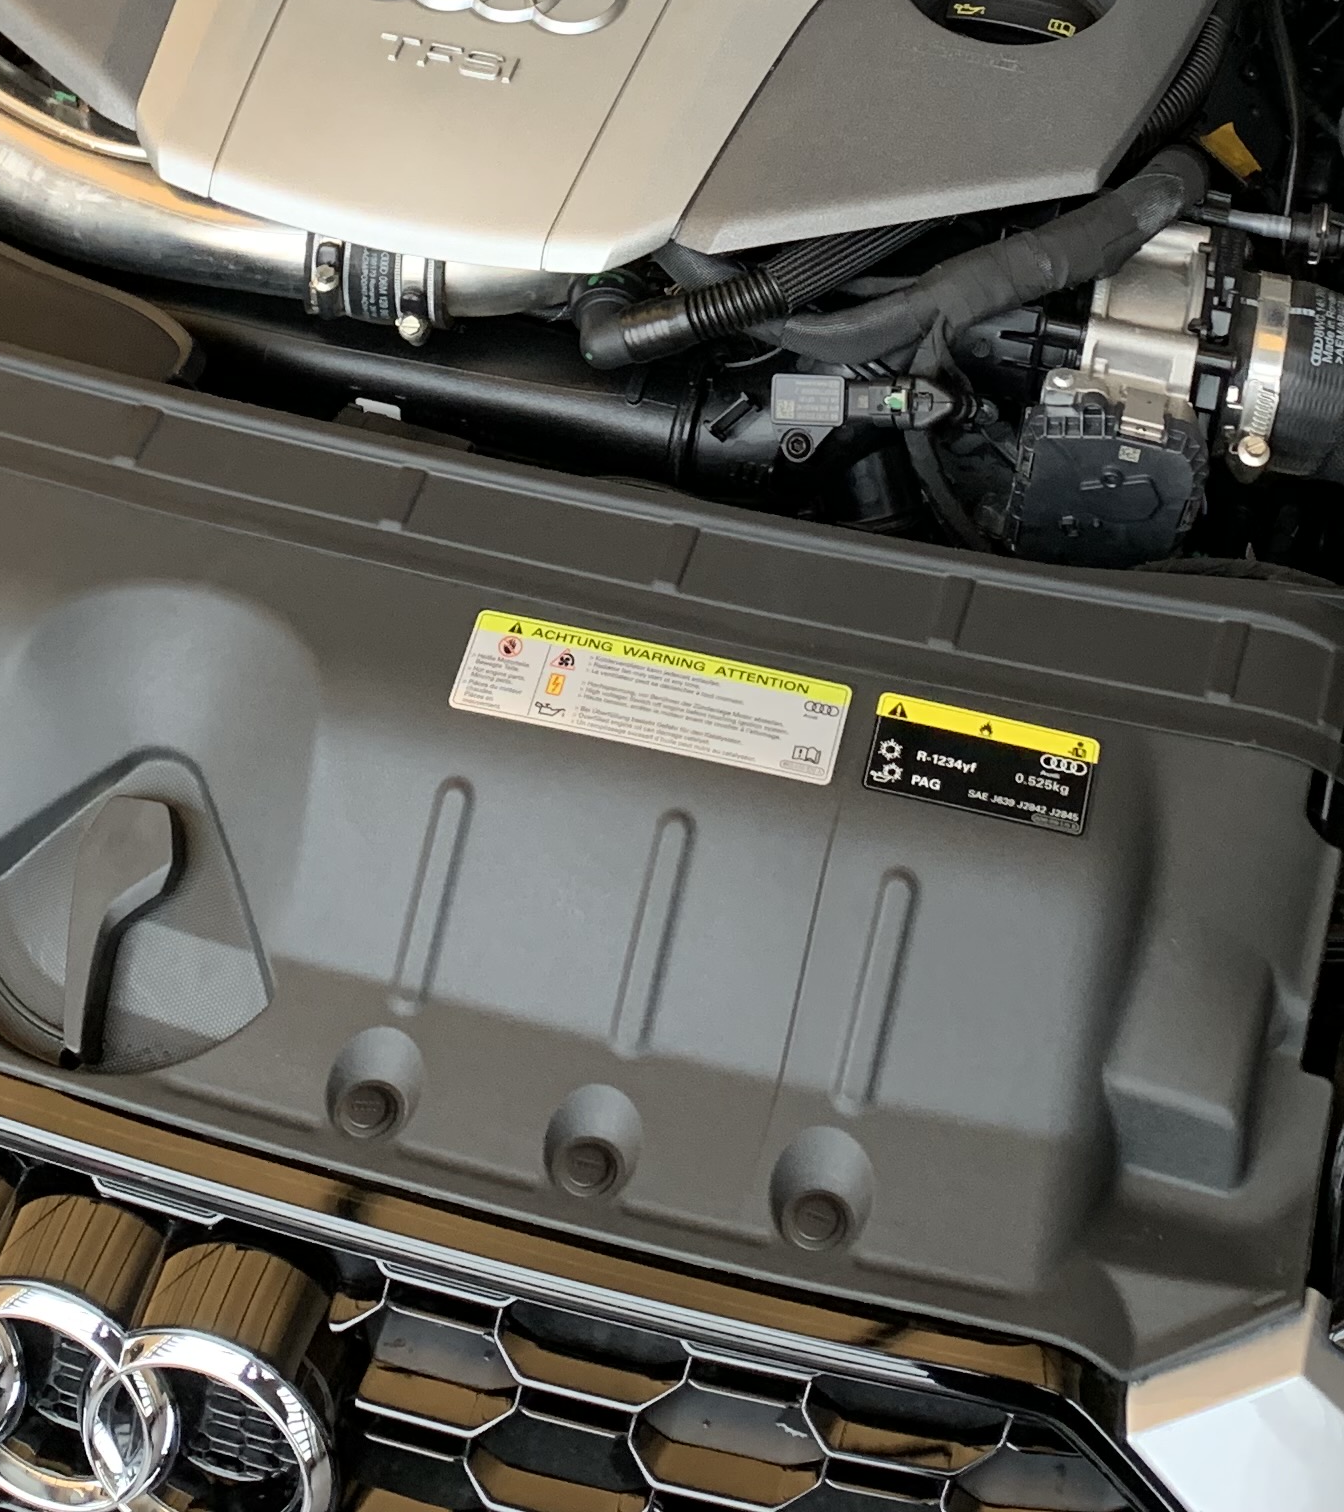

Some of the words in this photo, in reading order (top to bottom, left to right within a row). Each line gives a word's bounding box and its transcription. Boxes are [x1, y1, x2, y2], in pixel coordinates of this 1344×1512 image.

[379, 31, 524, 85] TFSI
[532, 627, 613, 652] ACHTUNG
[623, 645, 706, 672] WARNING
[714, 666, 810, 694] ATTENTION
[911, 774, 941, 791] PAG
[916, 750, 978, 774] R-1234yf
[1015, 772, 1070, 797] 0.525kg
[968, 789, 989, 802] SAE
